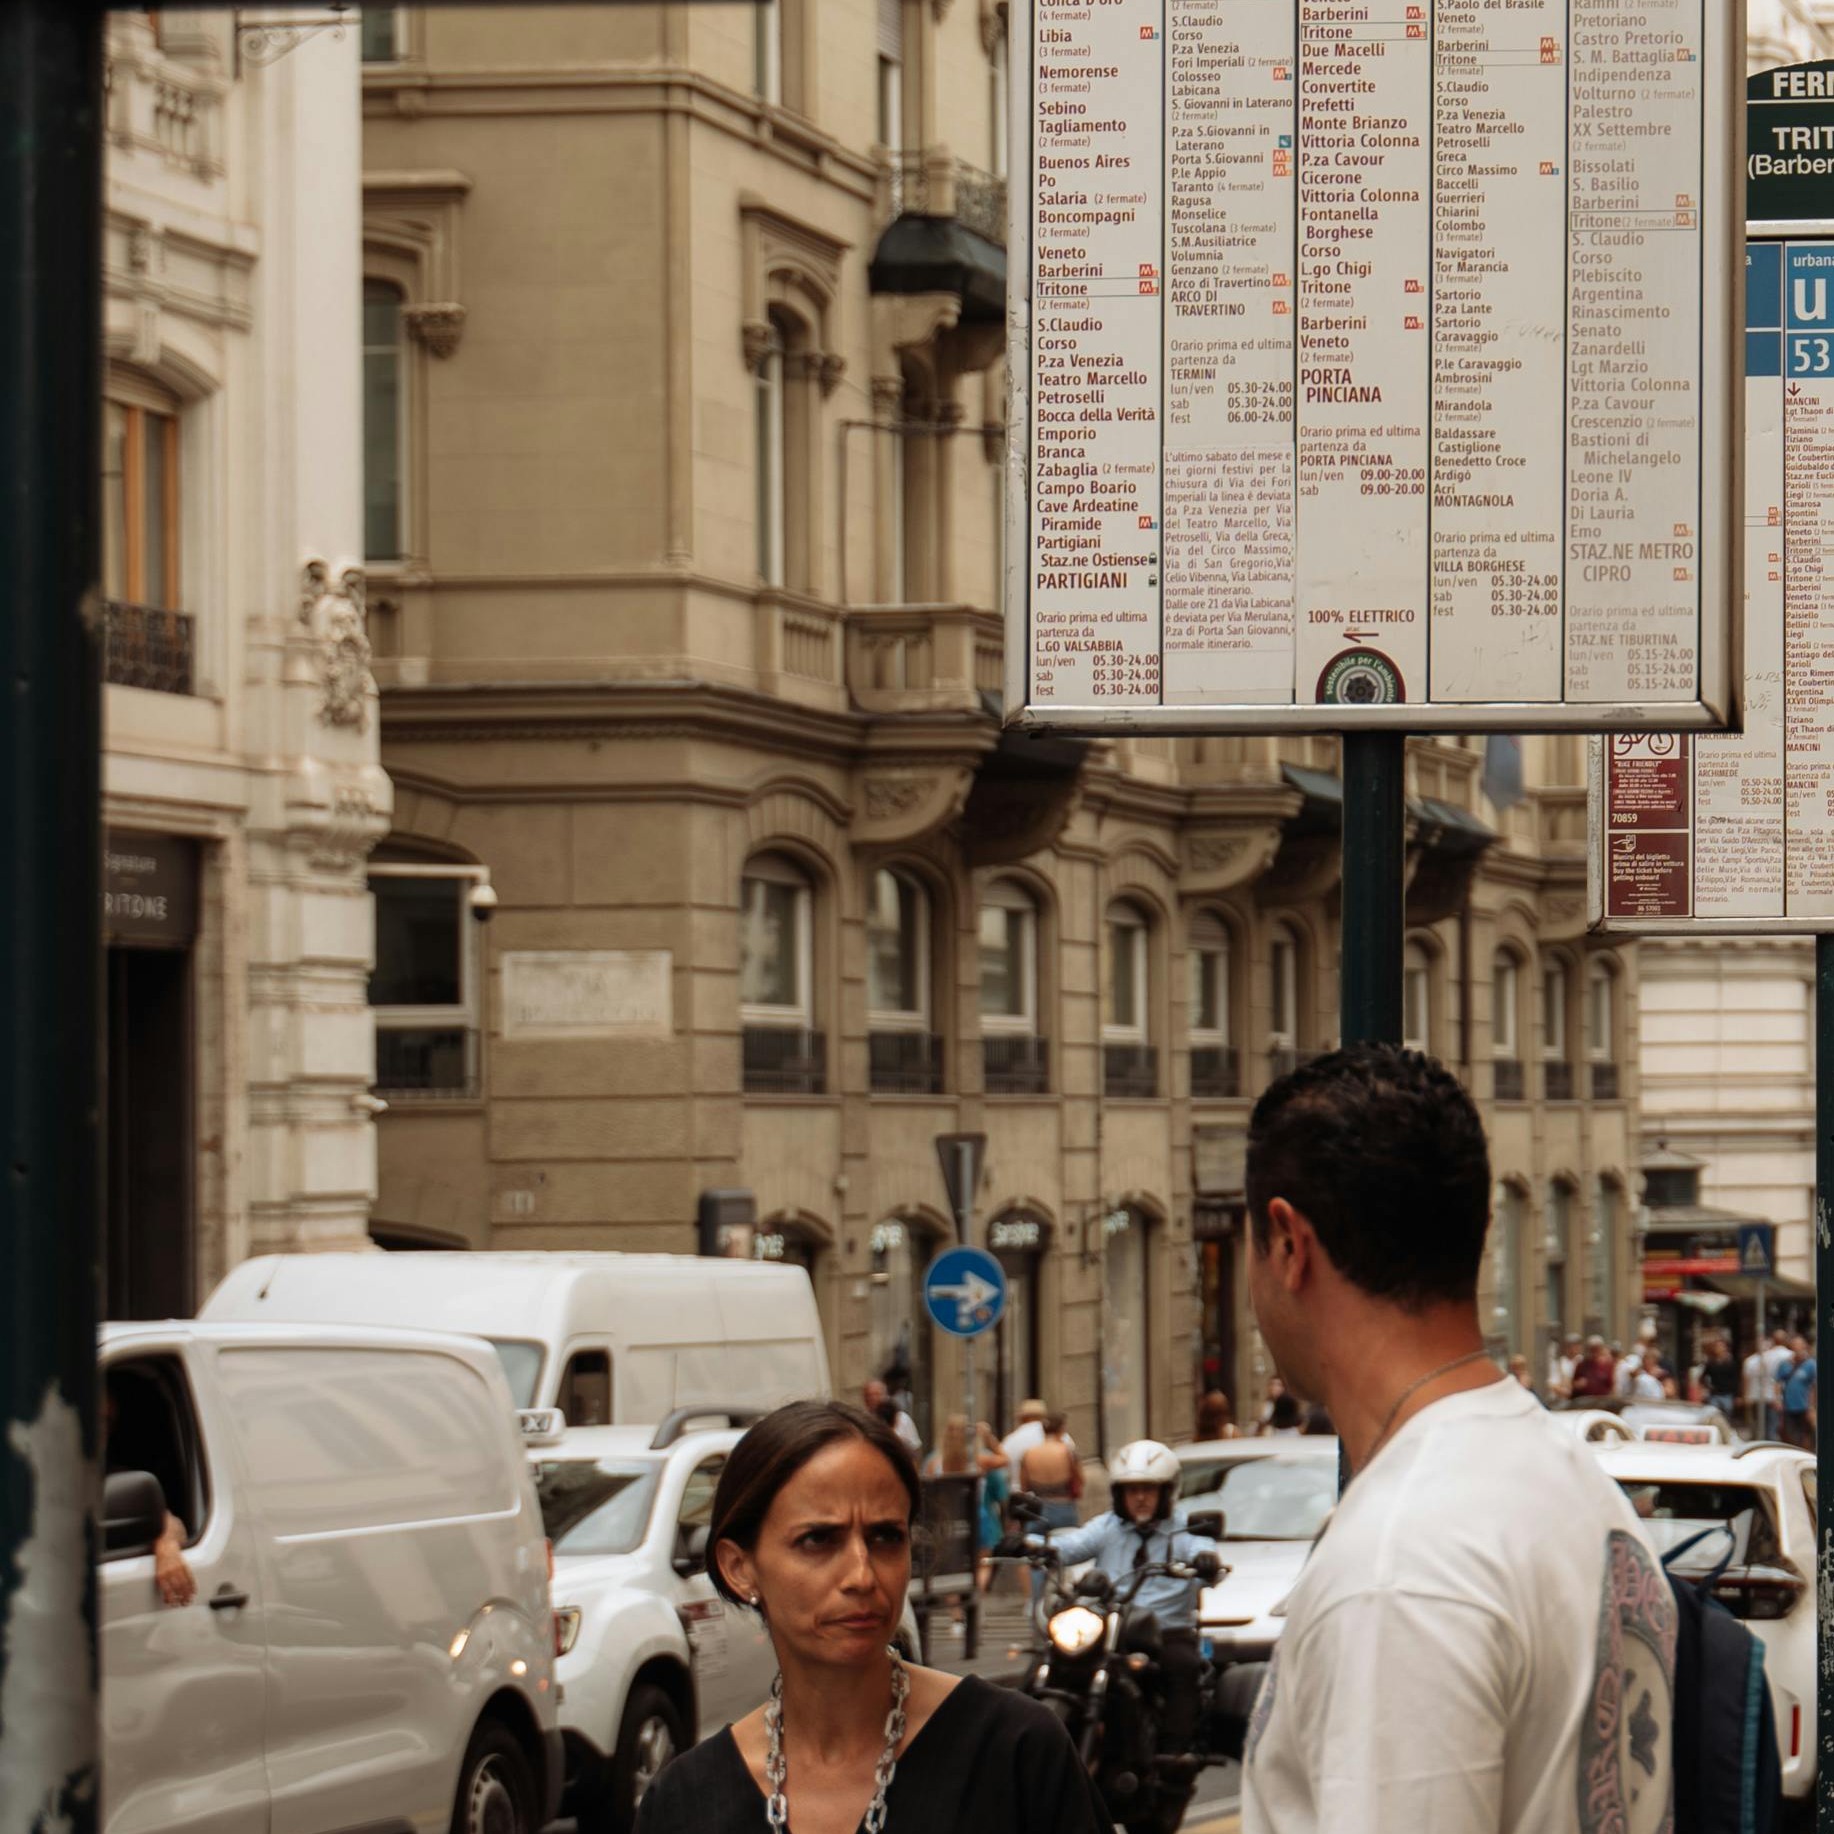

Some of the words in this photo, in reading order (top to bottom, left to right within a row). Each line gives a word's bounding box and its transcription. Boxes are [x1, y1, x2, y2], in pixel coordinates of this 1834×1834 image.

[1039, 10, 1048, 22] (4
[1051, 8, 1092, 21] fermate)
[1302, 43, 1329, 58] Due
[1334, 42, 1385, 57] Macelli
[1039, 65, 1119, 79] Nemorense
[1171, 70, 1221, 83] Colosseo
[1573, 67, 1672, 85] Indipendenza
[1301, 79, 1376, 94] Convertite
[1038, 118, 1127, 137] Tagliamento
[1572, 122, 1592, 137] XX
[1597, 121, 1672, 137] Settembre
[1301, 133, 1355, 149] Vittoria
[1360, 133, 1420, 148] Colonna
[1039, 155, 1090, 170] Buenos
[1095, 154, 1130, 168] Aires
[1436, 164, 1464, 176] Circo
[1467, 164, 1518, 176] Massimo
[1038, 190, 1088, 206] Salaria
[1094, 193, 1104, 206] (2
[1106, 192, 1147, 205] fermate)
[1038, 207, 1135, 226] Boncompagni
[1301, 206, 1379, 221] Fontanella
[1171, 235, 1257, 248] S.M.Ausiliatrice
[1435, 247, 1495, 262] Navigatori
[1794, 278, 1827, 321] u
[1175, 303, 1246, 317] TRAVERTINO
[1571, 340, 1645, 356] Zanardelli
[1794, 338, 1830, 372] 53
[1037, 372, 1082, 387] Teatro
[1086, 371, 1148, 386] Marcello
[1785, 397, 1820, 406] MANCINI
[1037, 408, 1076, 423] Bocca
[1079, 407, 1113, 422] della
[1116, 407, 1155, 422] Verità
[1205, 451, 1238, 462] sabato
[1240, 450, 1255, 461] del
[1260, 452, 1283, 461] mese
[1285, 451, 1292, 461] e
[1583, 450, 1682, 468] Michelangelo
[1433, 494, 1514, 507] MONTAGNOLA
[1037, 572, 1127, 590] PARTIGIANI
[1583, 564, 1632, 583] CIPRO
[1035, 611, 1067, 624] Orario
[1068, 613, 1098, 626] prima
[1100, 611, 1114, 623] ed
[1115, 611, 1148, 623] ultima
[1308, 609, 1344, 624] 100%
[1349, 609, 1415, 623] ELETTRICO
[1035, 654, 1076, 668] lun/ven
[1092, 654, 1159, 667] 05.30-24.00
[1627, 648, 1694, 661] 05.15-24.00
[1325, 656, 1356, 695] sostenibile
[1358, 656, 1375, 666] per
[1611, 812, 1638, 823] 70859
